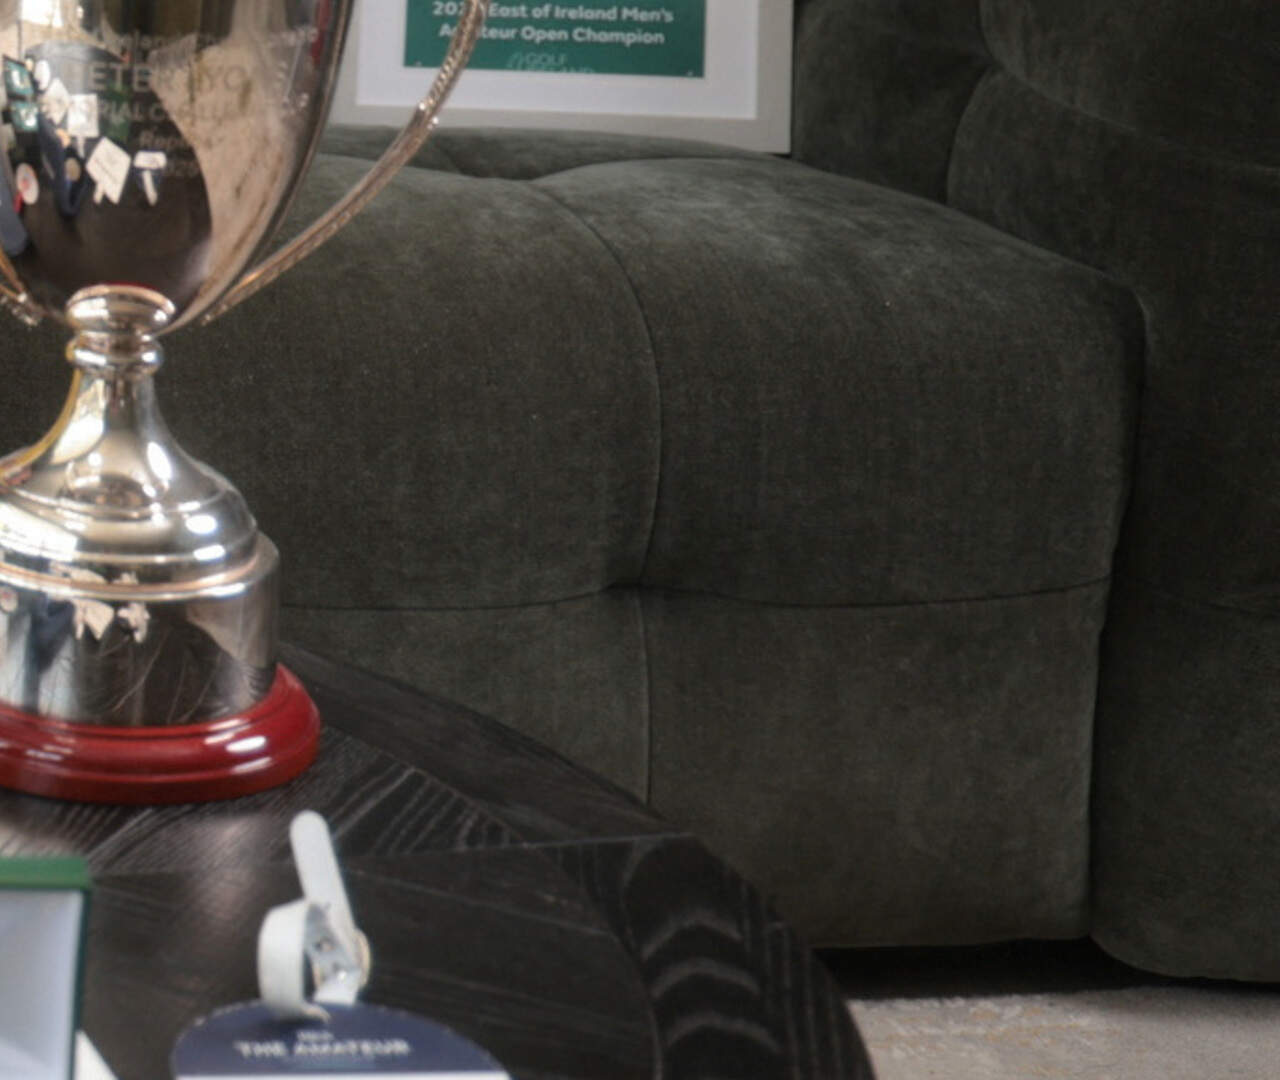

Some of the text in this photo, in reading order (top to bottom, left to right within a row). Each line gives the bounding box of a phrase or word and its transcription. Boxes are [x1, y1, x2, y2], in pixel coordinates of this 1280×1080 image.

[489, 3, 528, 18] East
[532, 3, 553, 19] of
[554, 5, 617, 21] Ireland
[621, 7, 674, 23] Men's
[438, 23, 665, 48] Ateur Open Champion
[235, 1038, 411, 1057] THE AMATEUR
